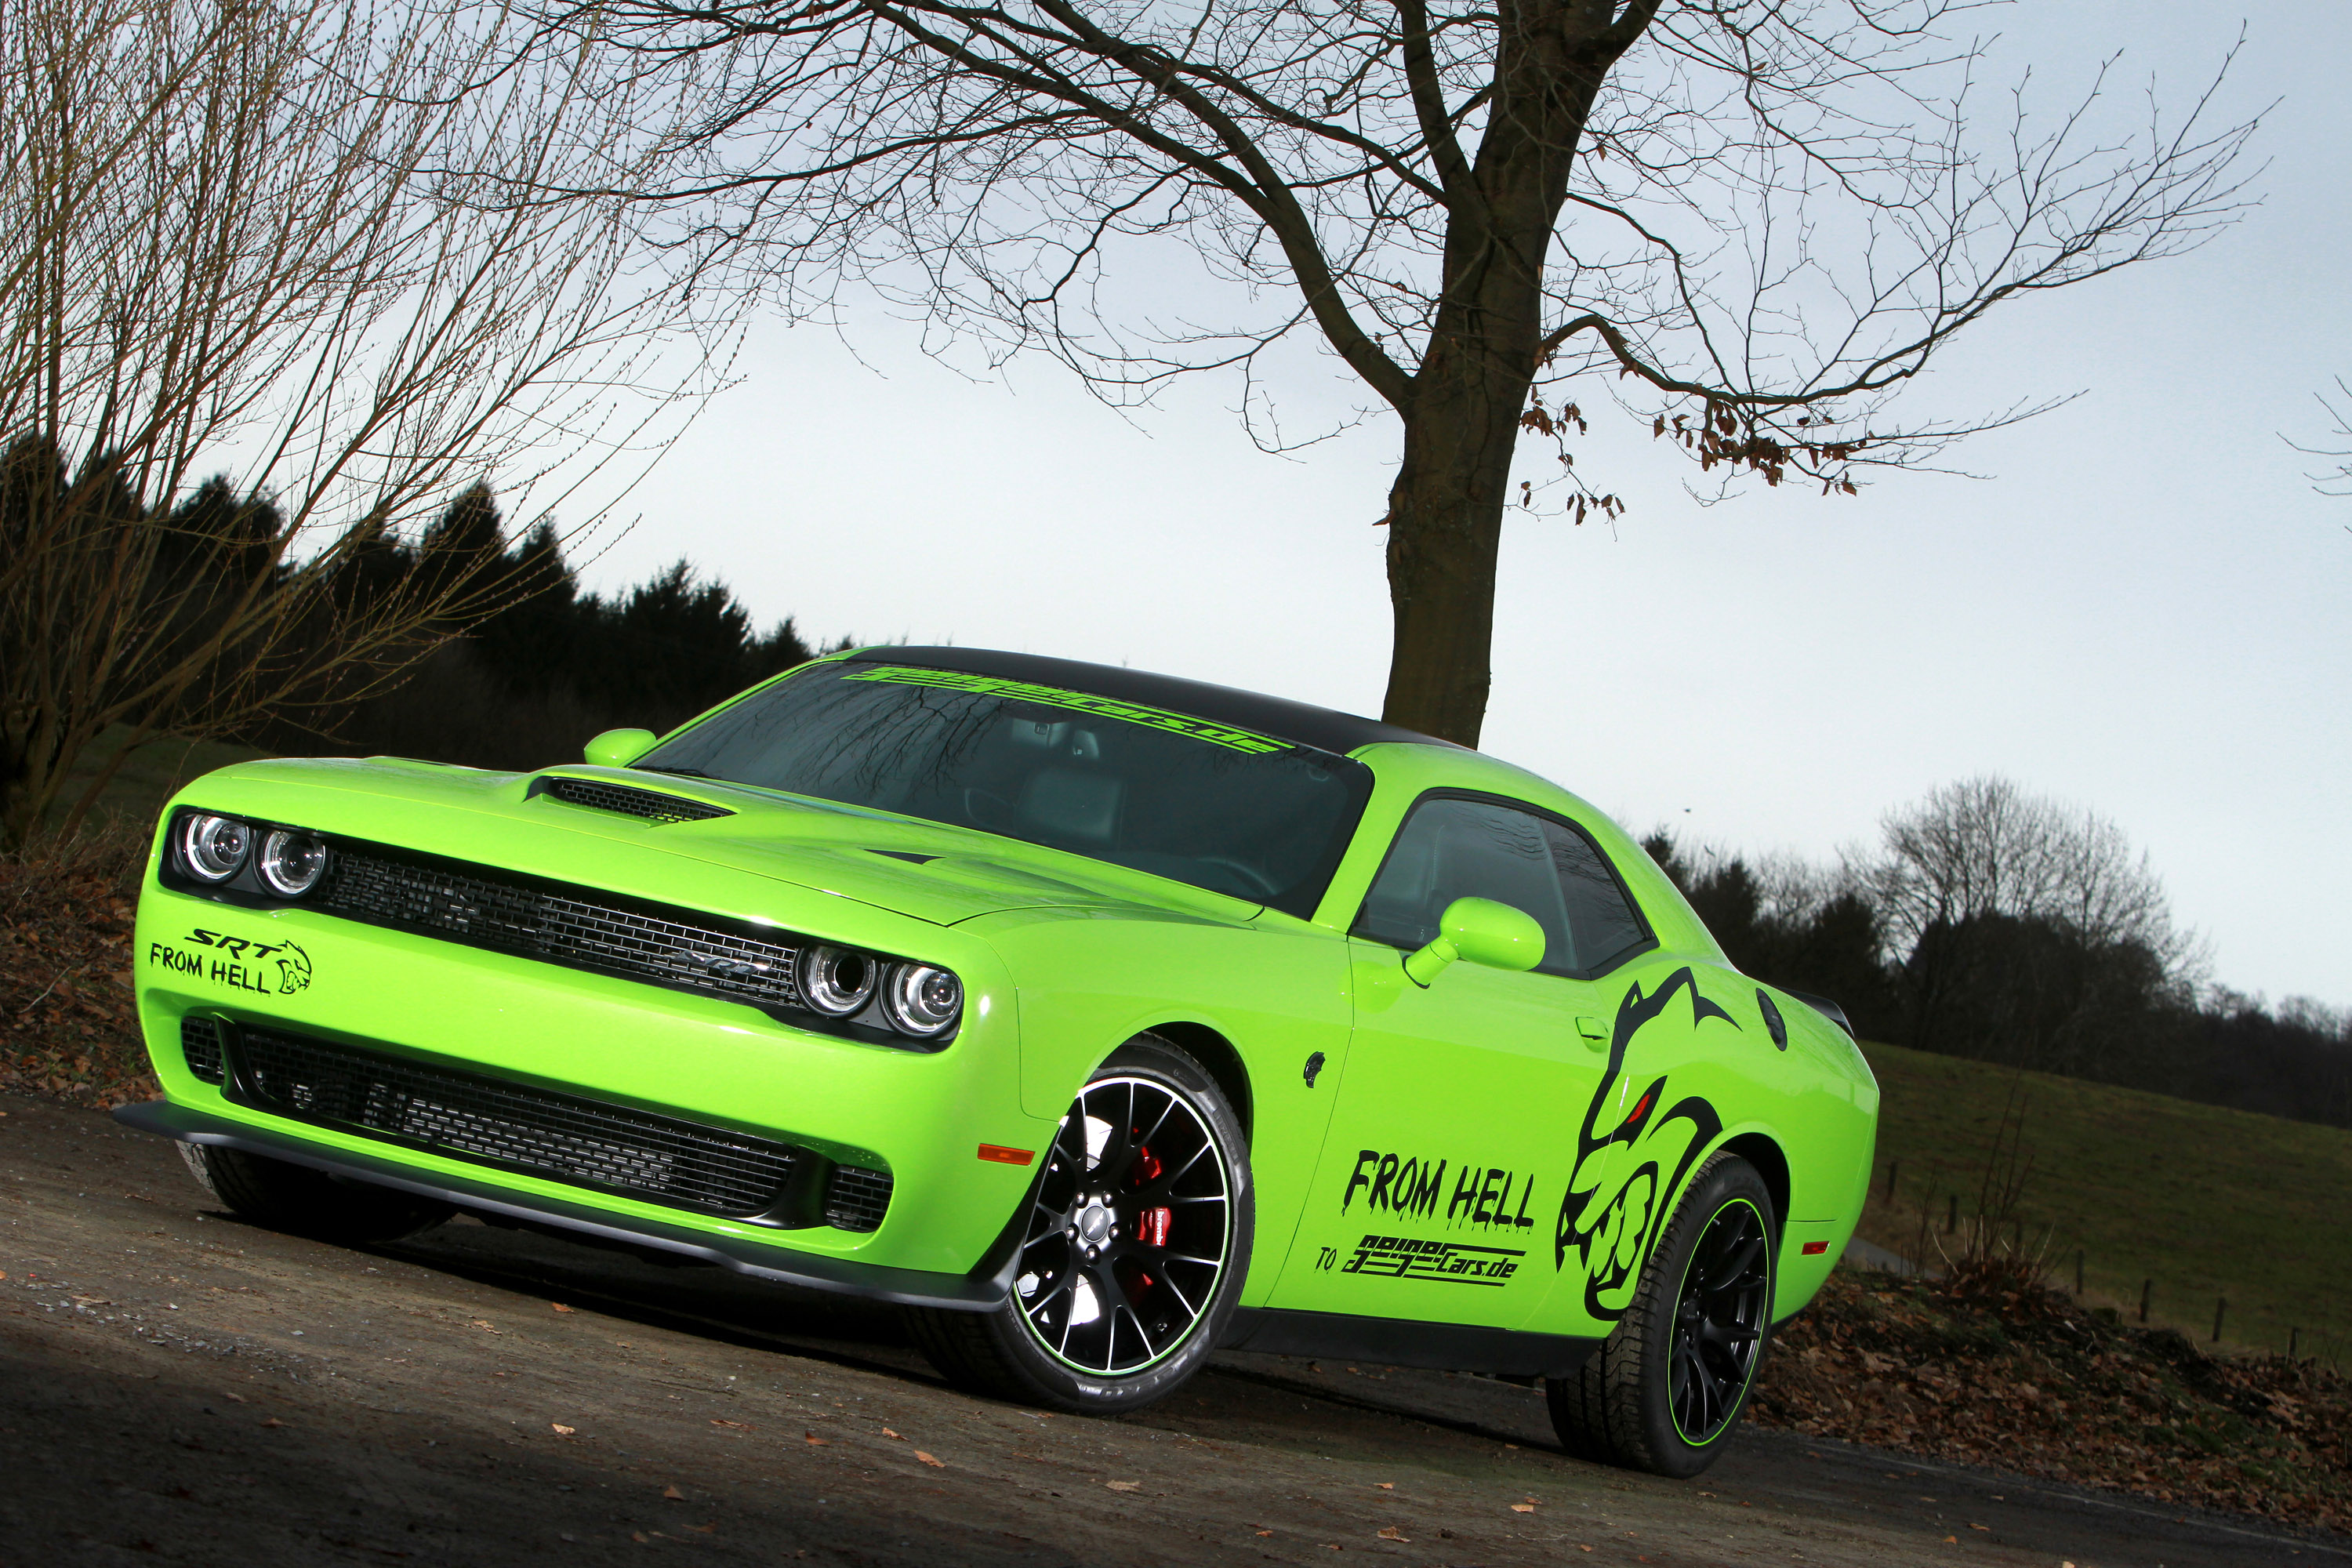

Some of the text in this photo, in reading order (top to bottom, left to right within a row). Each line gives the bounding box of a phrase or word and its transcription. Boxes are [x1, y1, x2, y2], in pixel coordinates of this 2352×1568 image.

[184, 928, 283, 960] SRT
[150, 942, 271, 996] FROM HELL
[1341, 1150, 1534, 1234] FROM HELL
[1314, 1247, 1337, 1274] TO
